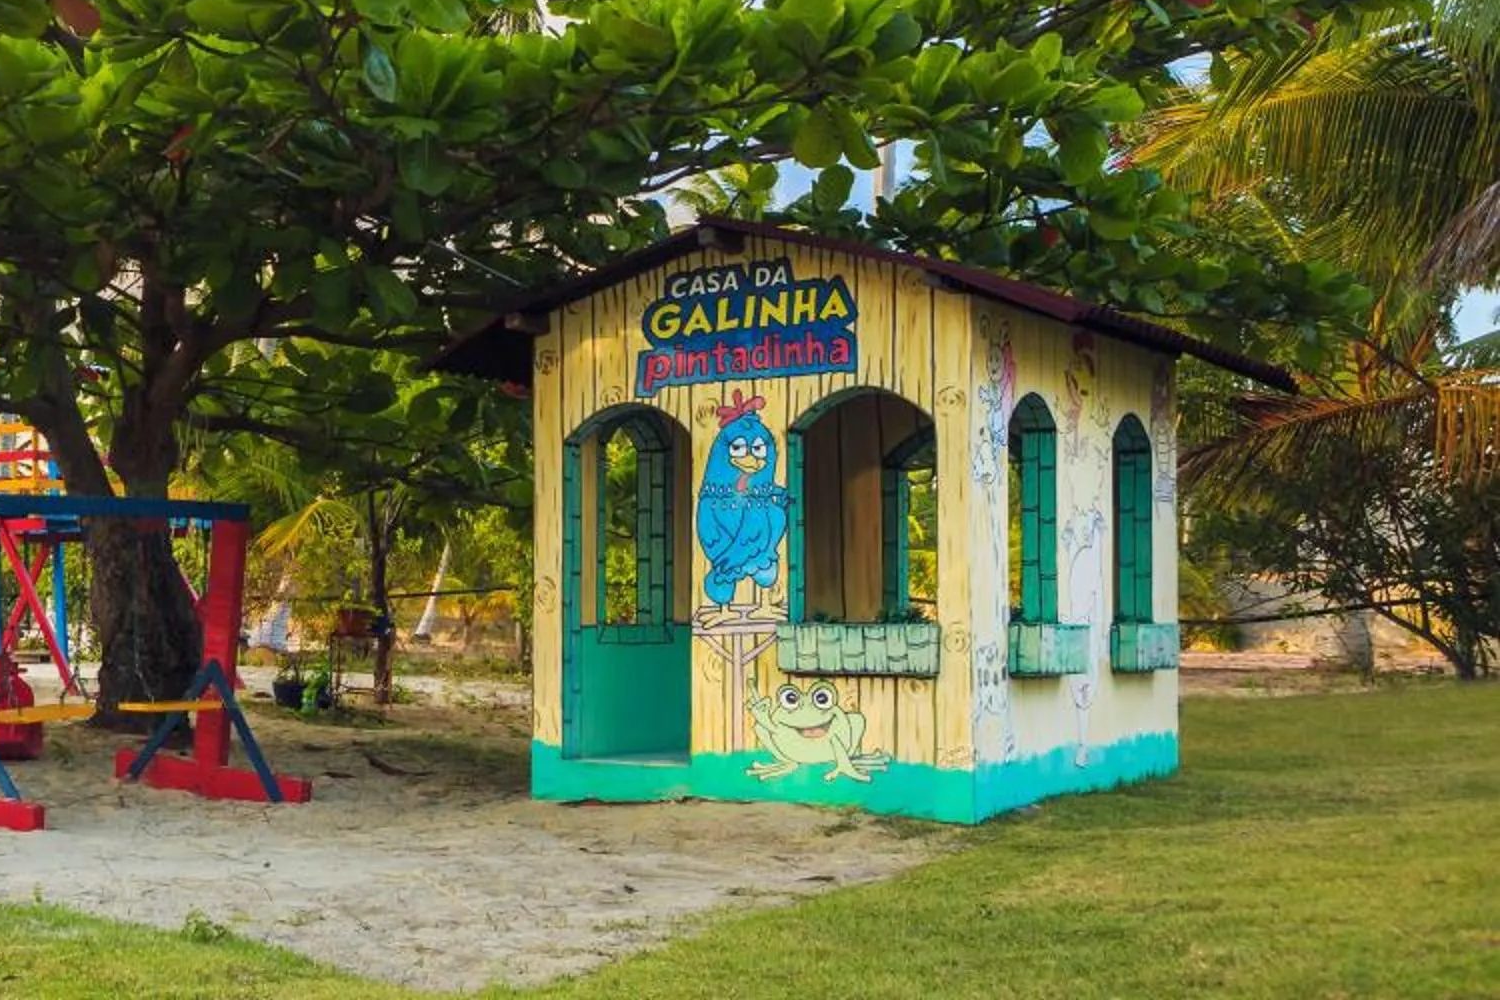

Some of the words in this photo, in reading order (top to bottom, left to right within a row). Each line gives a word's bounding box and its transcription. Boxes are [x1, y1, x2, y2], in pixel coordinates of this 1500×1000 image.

[671, 271, 739, 299] CASA
[755, 265, 788, 288] DA
[650, 288, 848, 339] GALINHA
[643, 332, 849, 391] pintadinha
